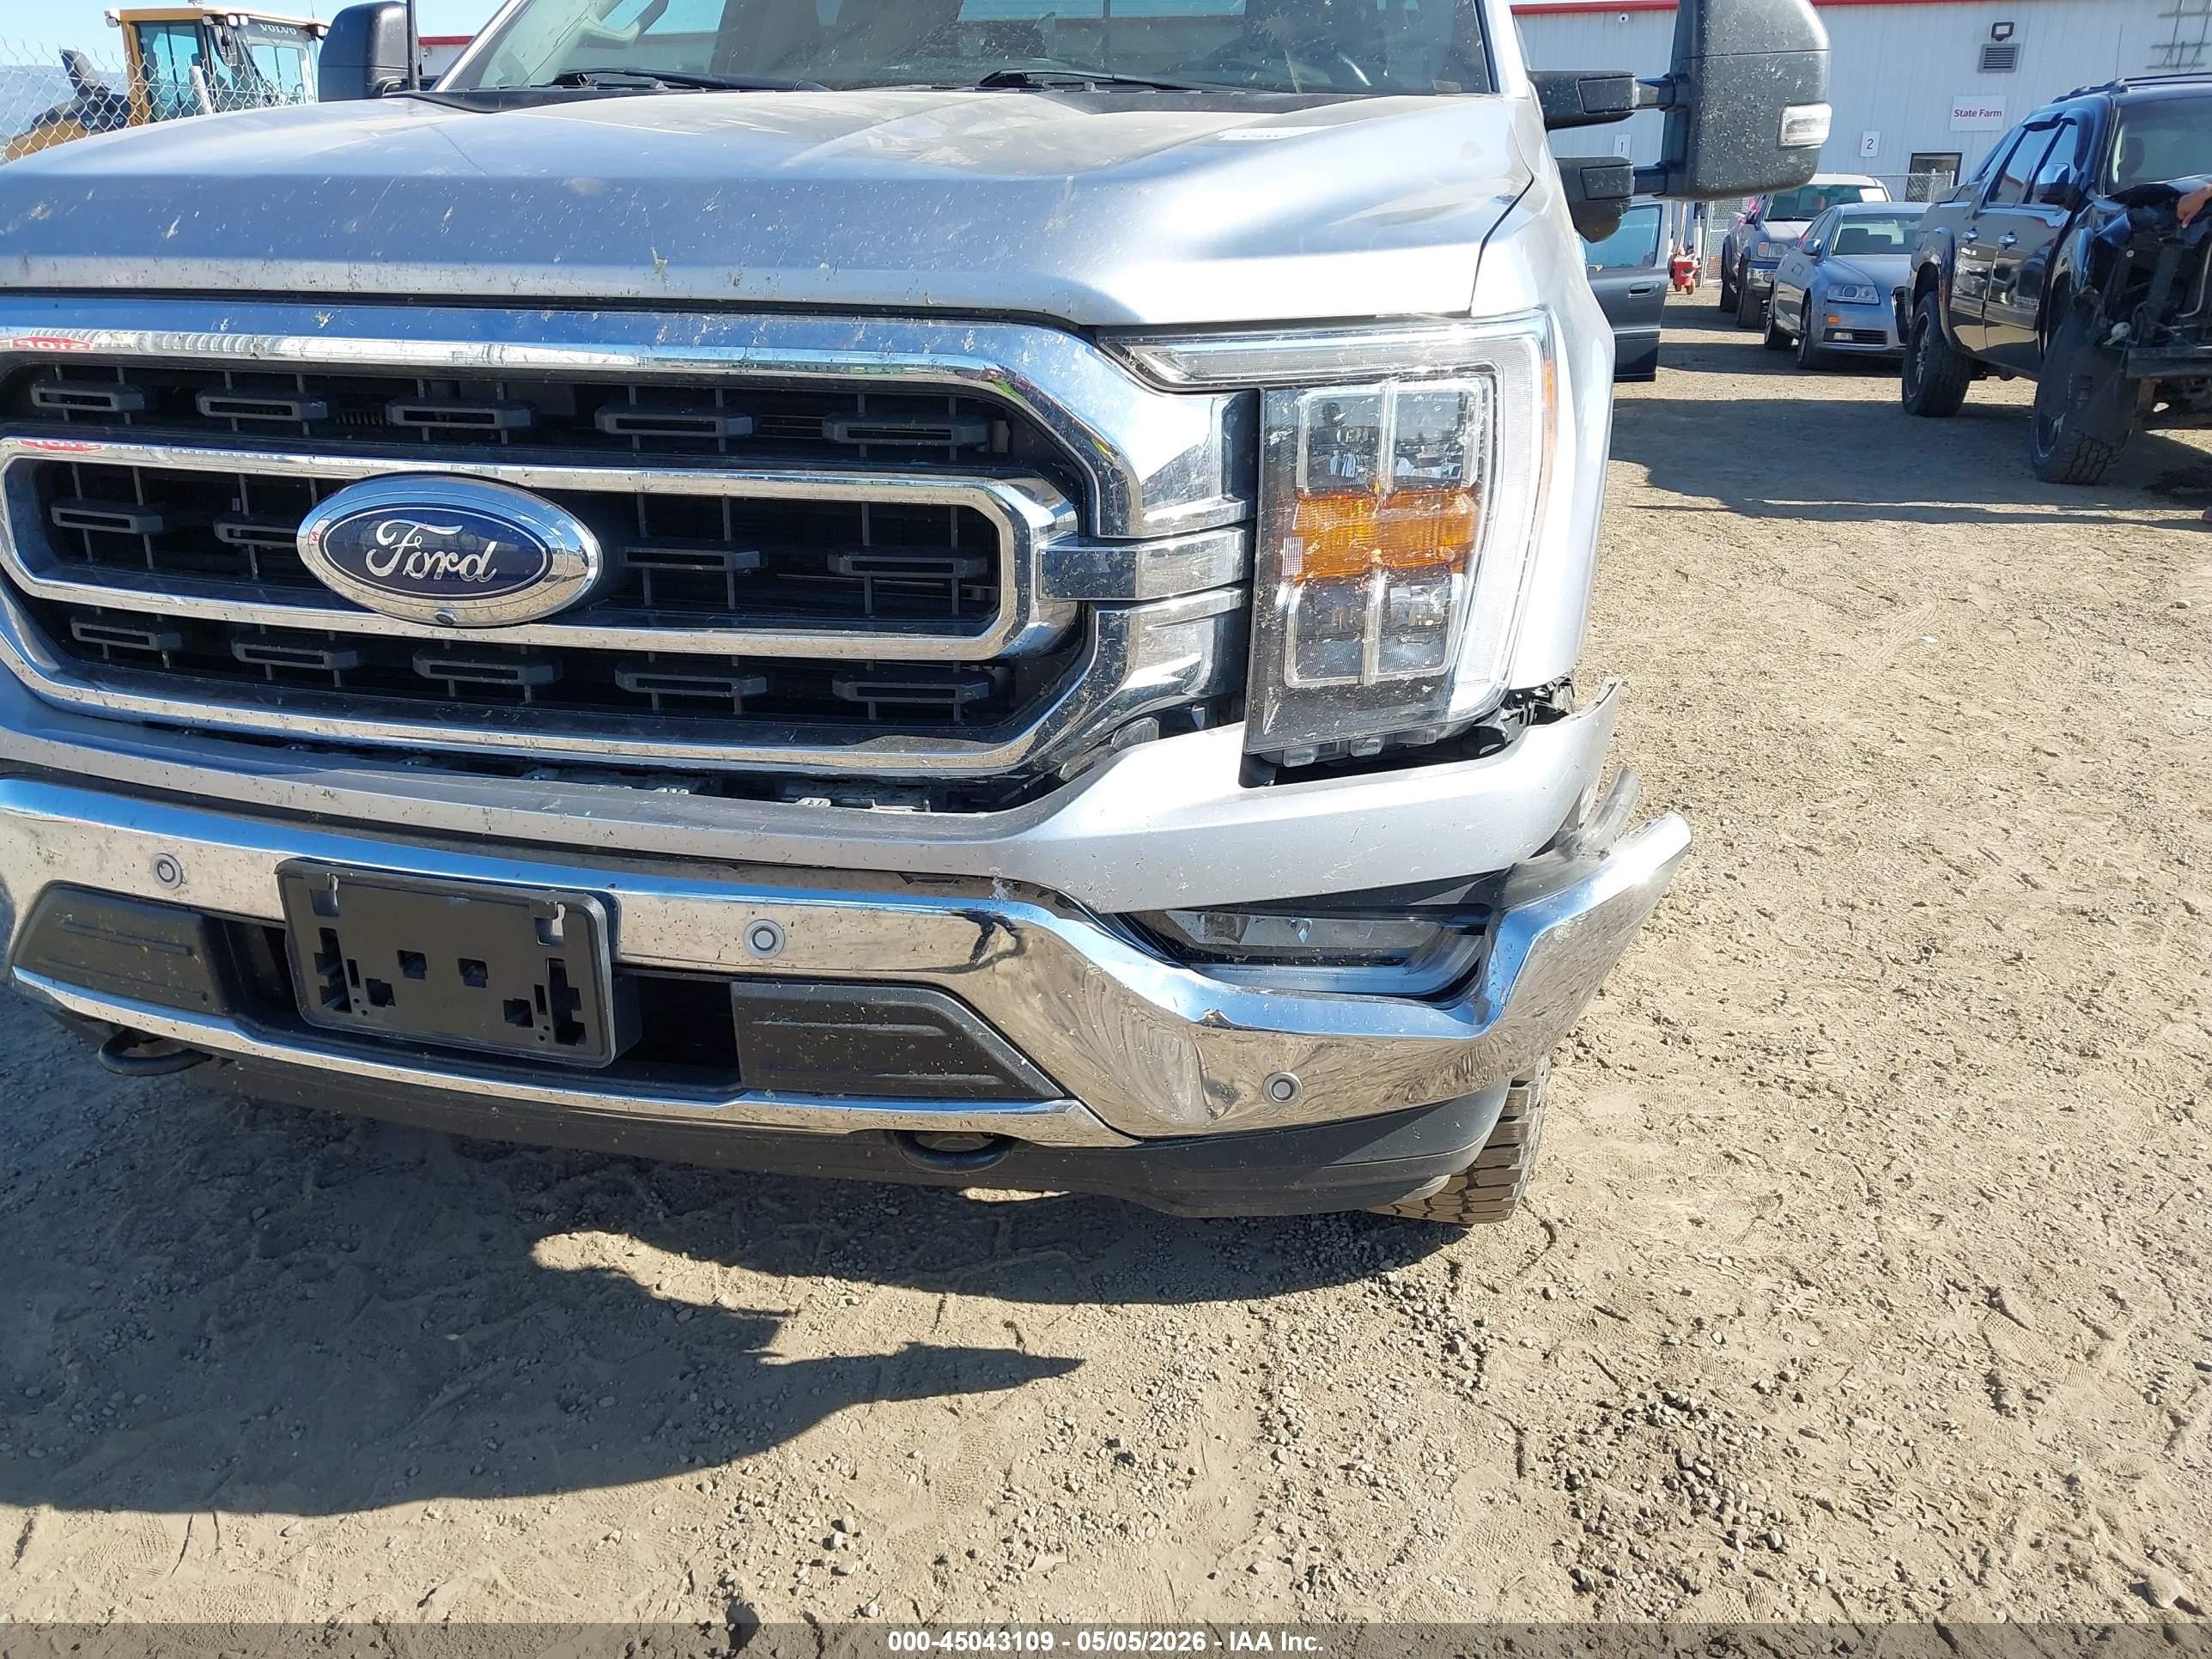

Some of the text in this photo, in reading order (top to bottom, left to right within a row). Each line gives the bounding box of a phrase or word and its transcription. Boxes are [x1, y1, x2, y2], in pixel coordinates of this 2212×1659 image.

[258, 23, 297, 35] VOLVO
[1954, 109, 2002, 118] State Farm
[1867, 138, 1874, 149] 2
[364, 519, 498, 583] Ford
